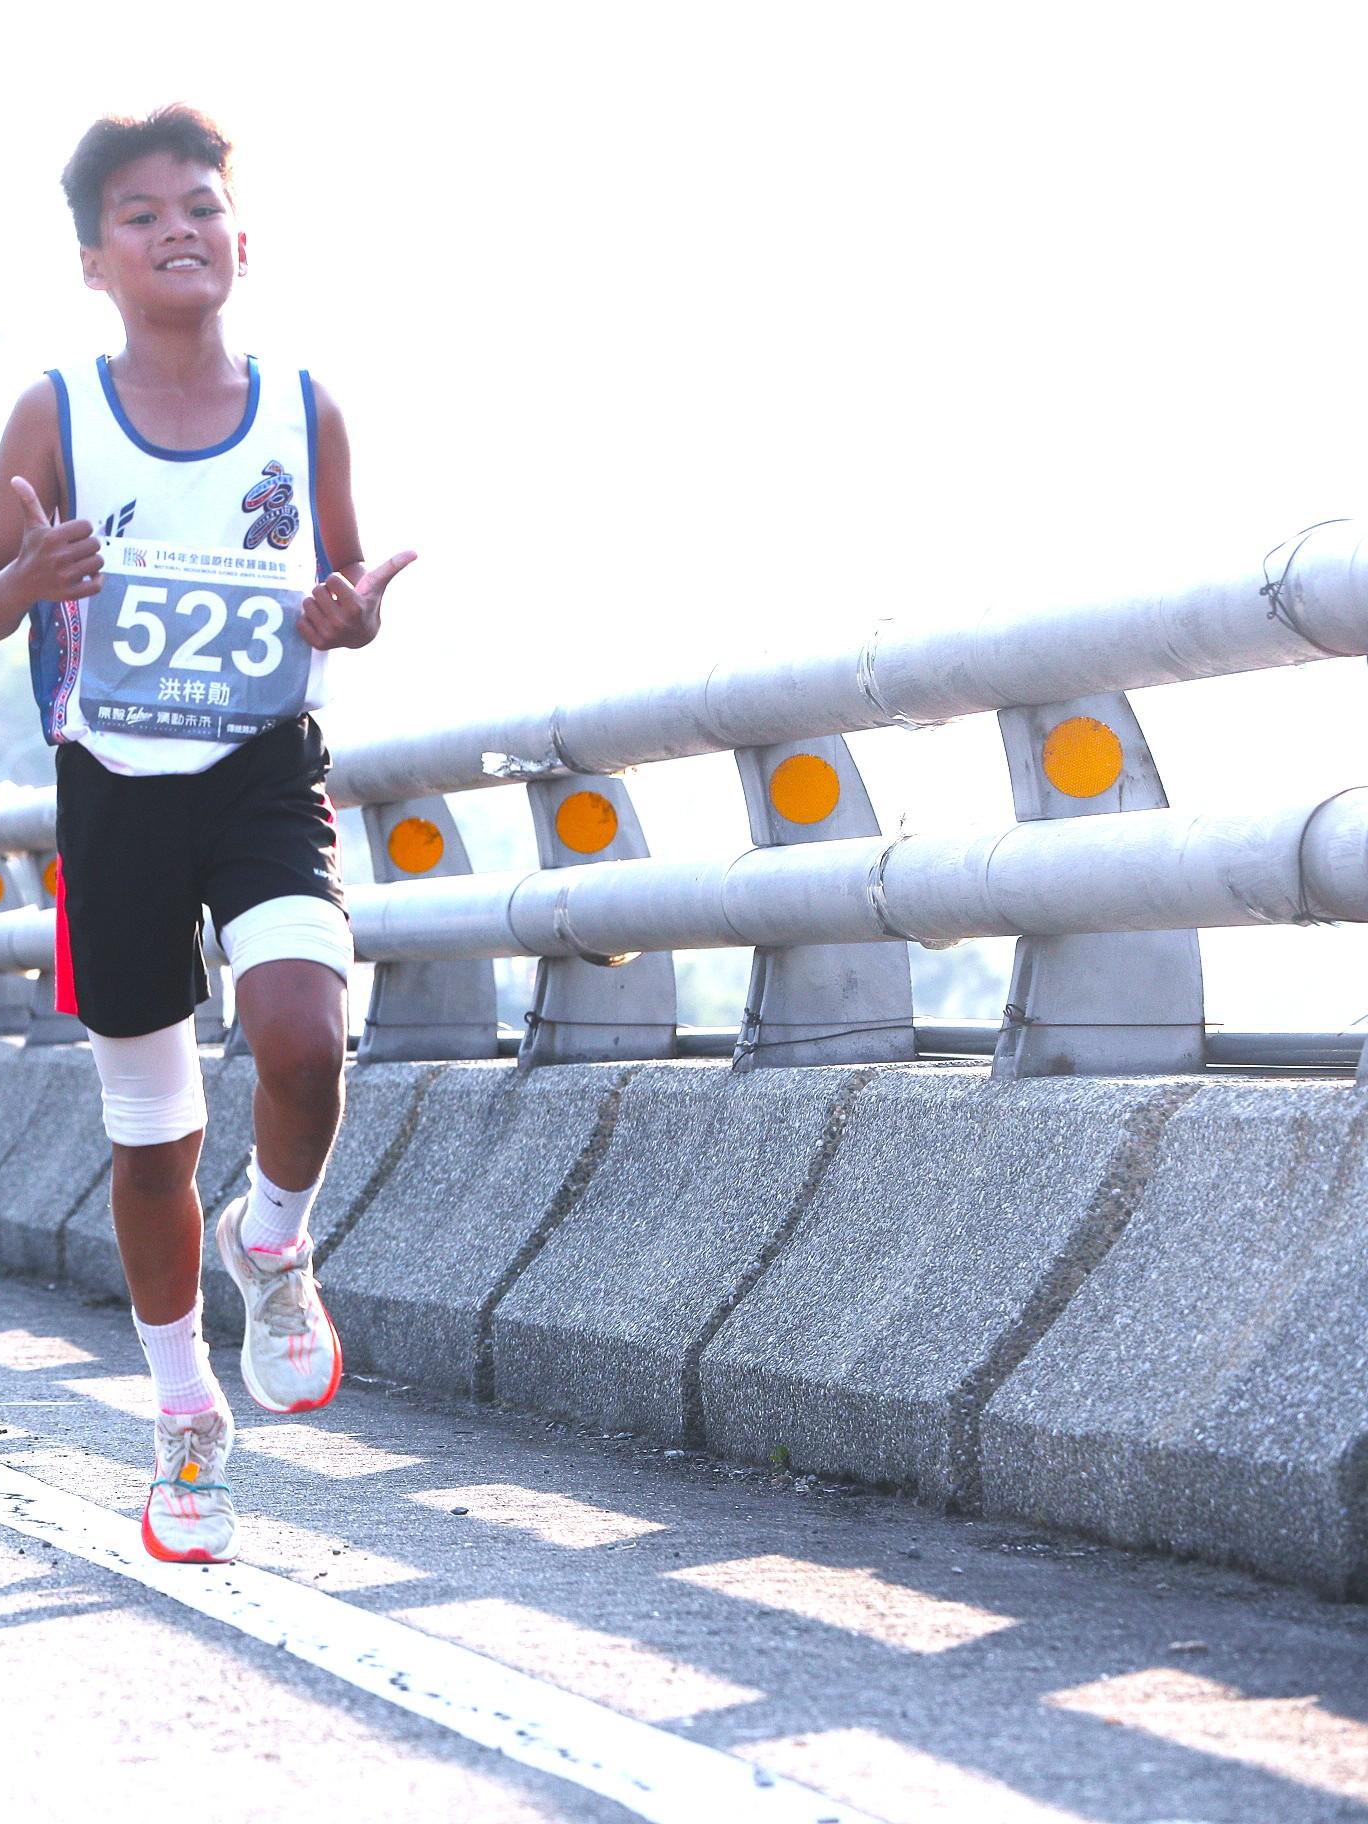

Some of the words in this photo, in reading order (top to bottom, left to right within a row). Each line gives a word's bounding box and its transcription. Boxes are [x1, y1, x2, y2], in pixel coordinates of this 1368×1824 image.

[112, 584, 284, 678] 523
[157, 677, 231, 706] 洪梓勛
